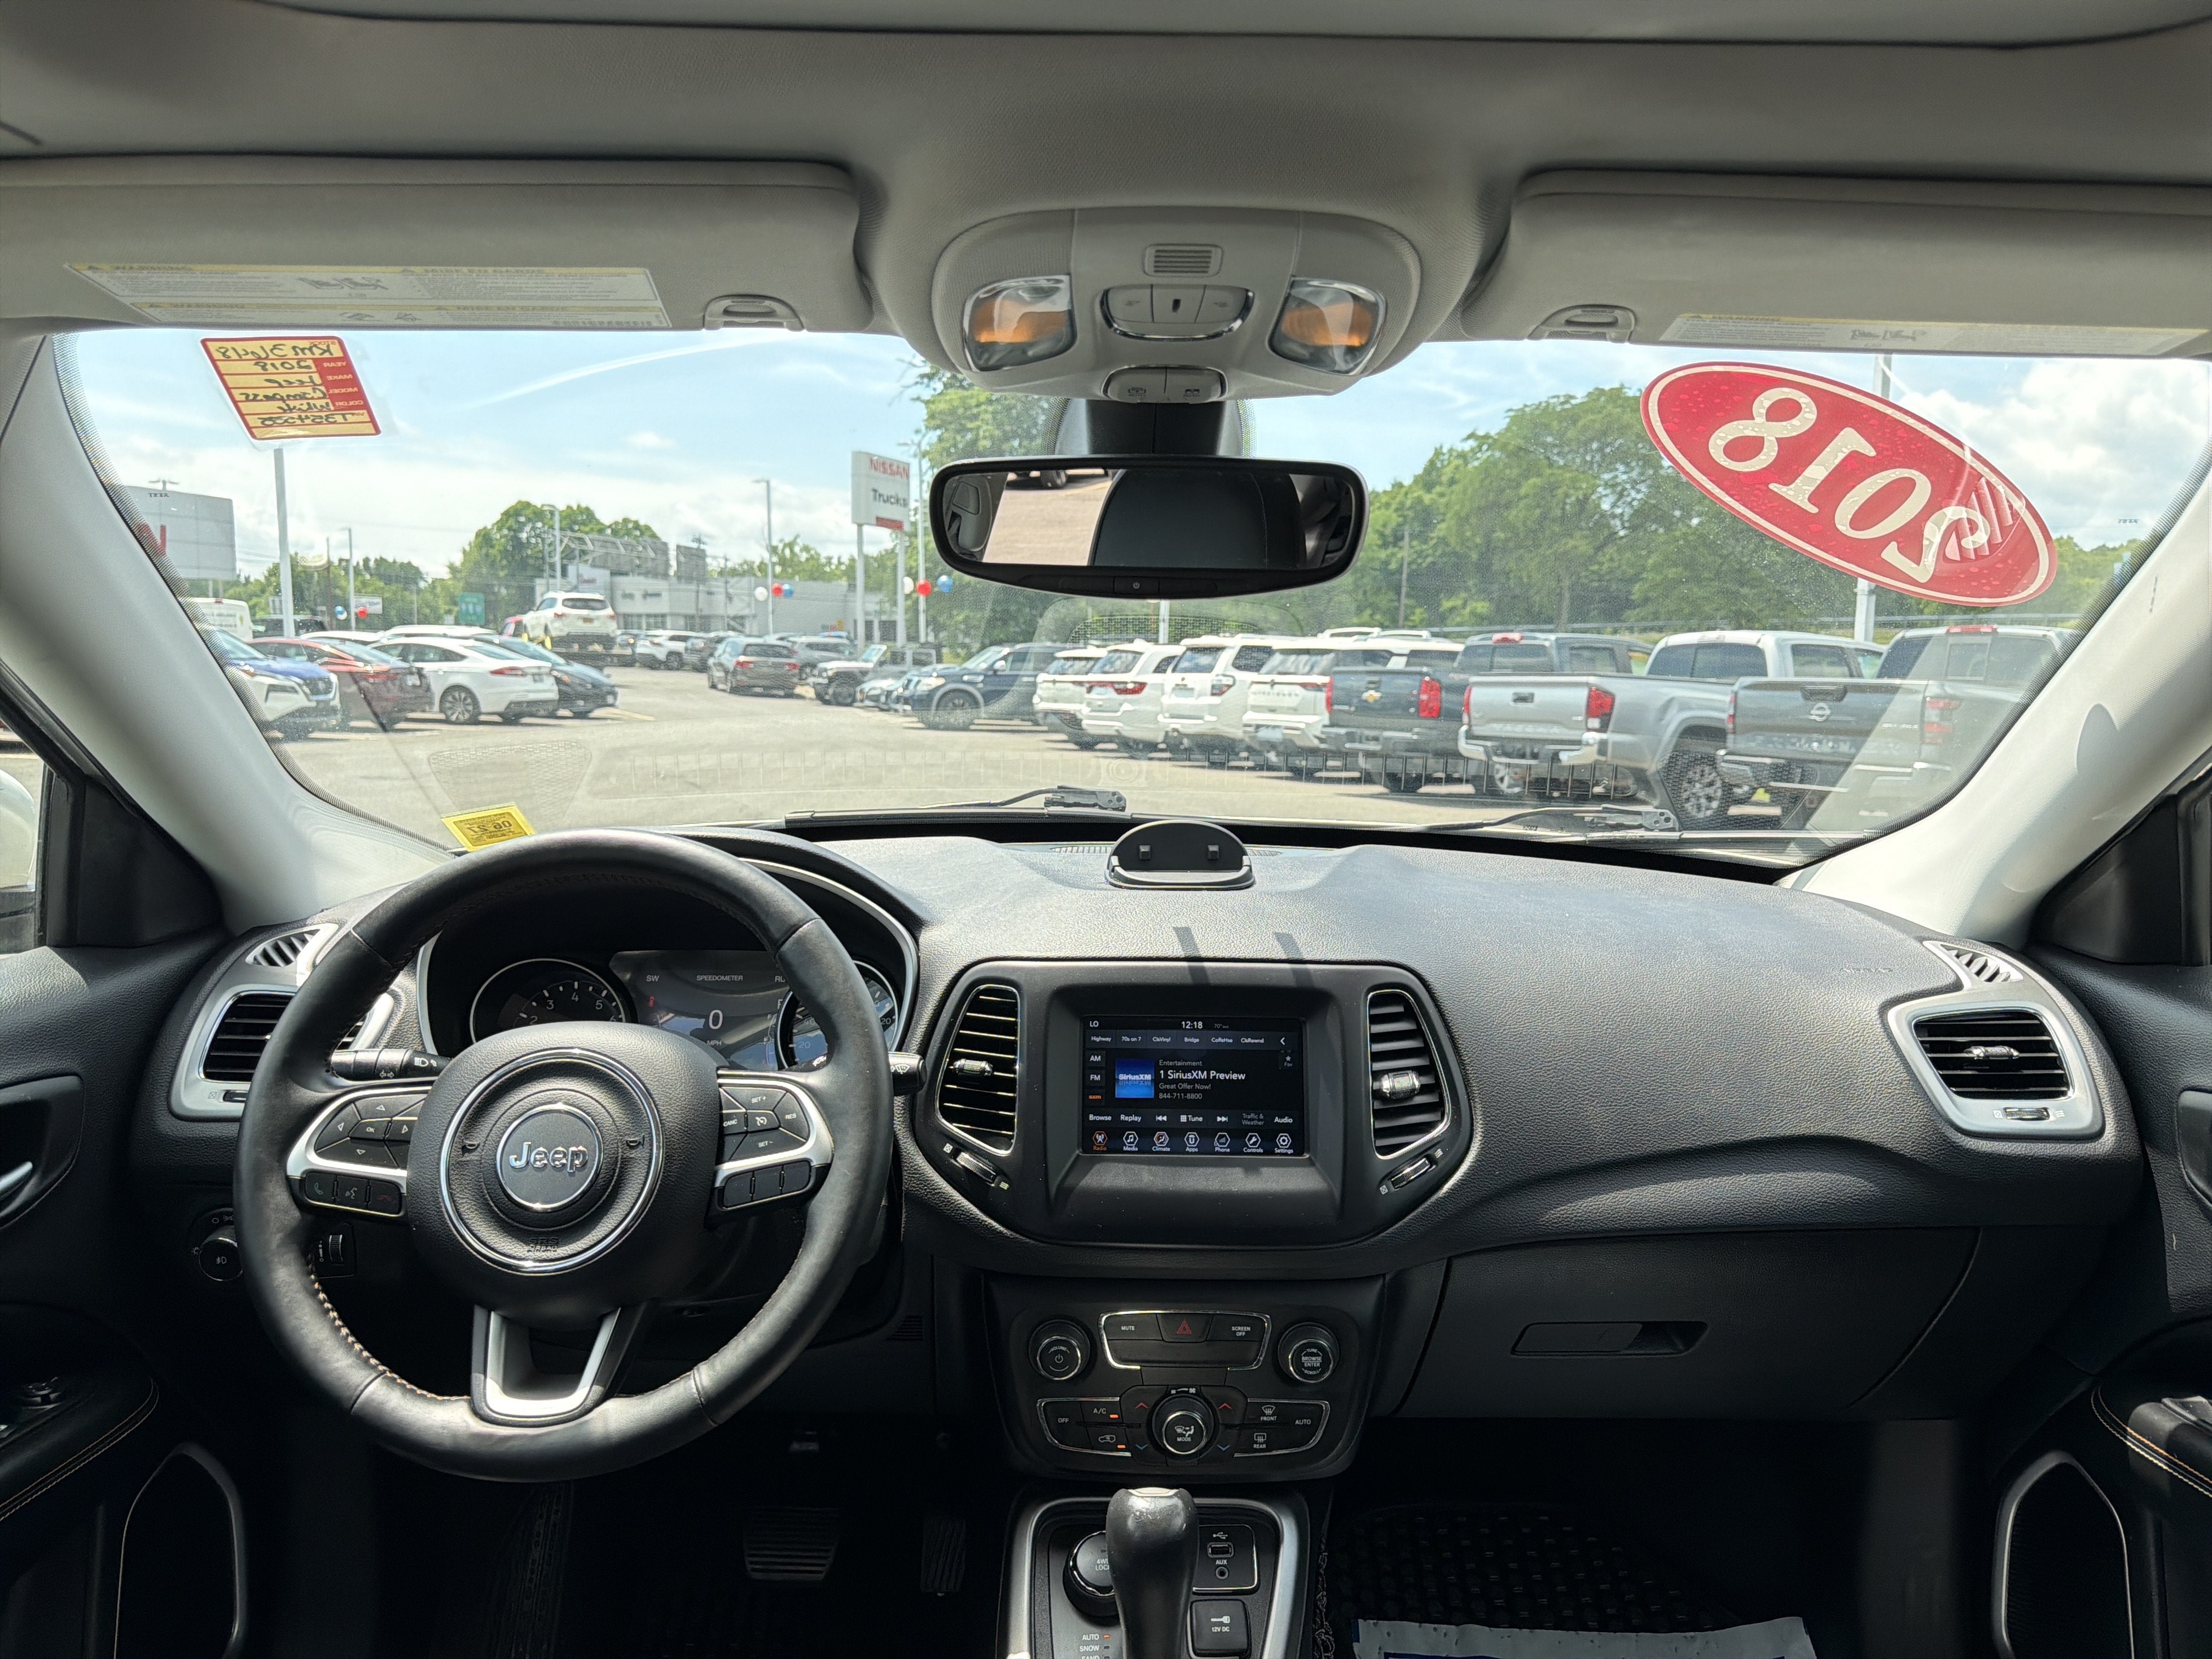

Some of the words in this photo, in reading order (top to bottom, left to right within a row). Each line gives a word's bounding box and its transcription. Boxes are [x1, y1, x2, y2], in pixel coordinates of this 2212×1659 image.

[870, 457, 909, 480] NISSAN
[872, 488, 909, 508] Trucks
[571, 992, 579, 1002] 4
[546, 1000, 554, 1009] 3
[595, 1000, 603, 1010] 5
[709, 1009, 723, 1030] 0
[1181, 1021, 1203, 1029] 12:18
[1160, 1070, 1164, 1079] 1
[1167, 1070, 1207, 1079] SiriusXM
[1210, 1071, 1246, 1080] Preview
[723, 1119, 738, 1127] CANC
[1120, 1114, 1142, 1122] Replay
[509, 1142, 589, 1173] Jeep
[527, 1244, 558, 1253] AIRBAG
